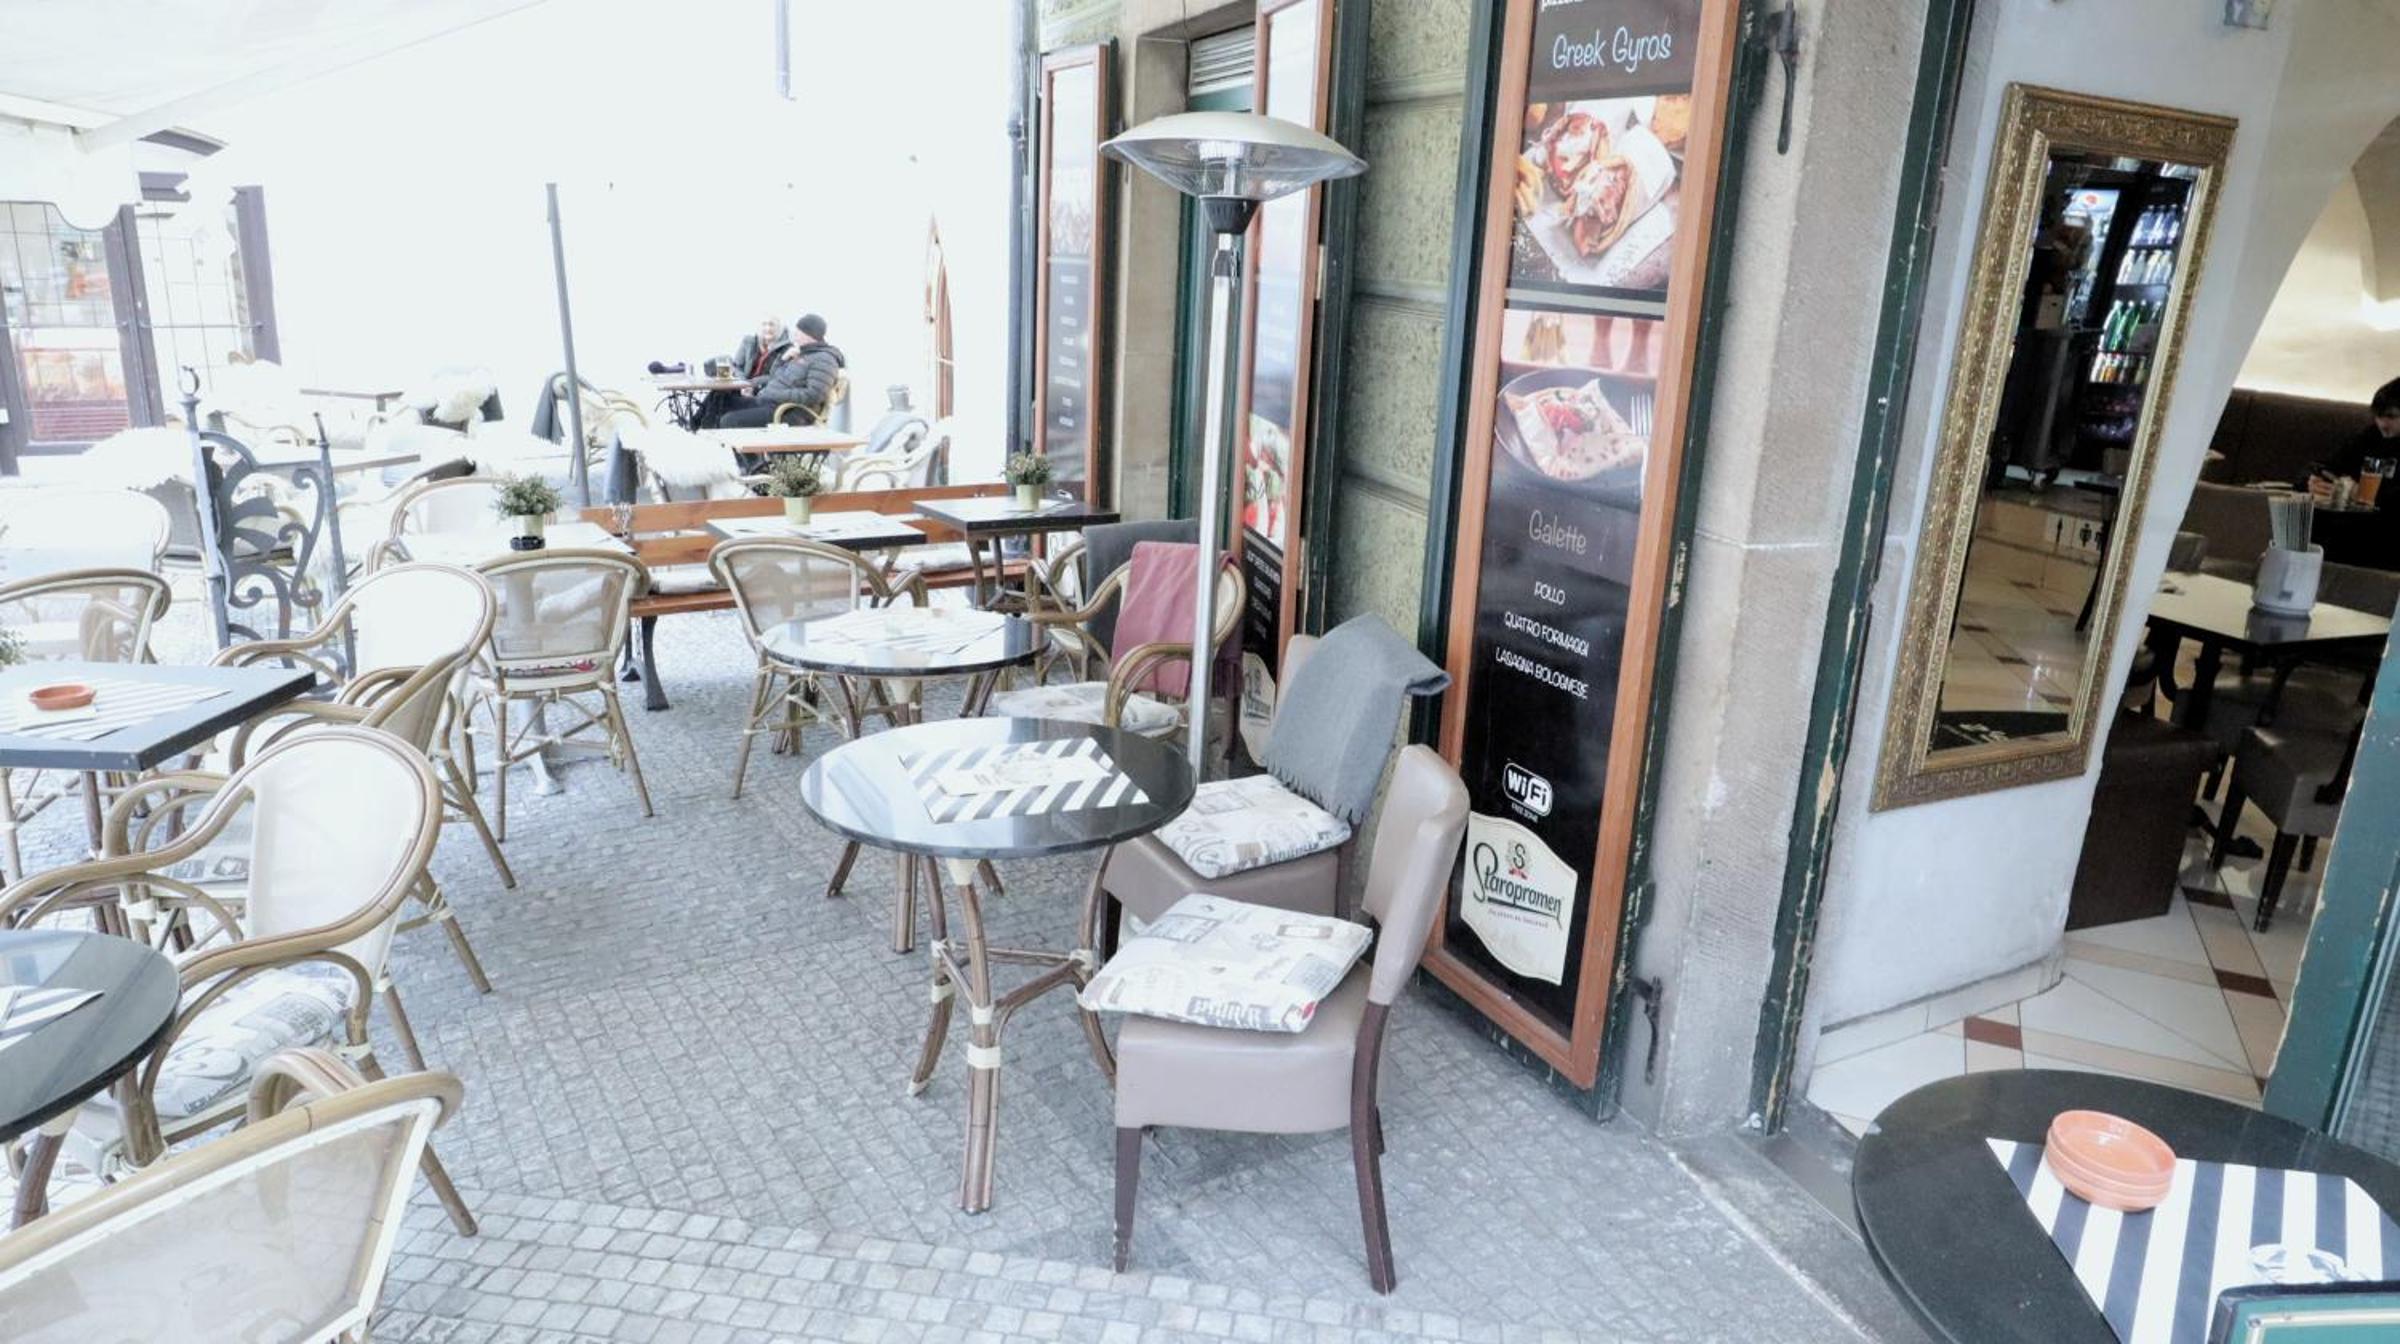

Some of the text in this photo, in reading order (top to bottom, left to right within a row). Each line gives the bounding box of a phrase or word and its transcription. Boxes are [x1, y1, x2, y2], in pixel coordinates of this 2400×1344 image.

[1553, 25, 1672, 73] Greek Gyros
[1529, 509, 1587, 555] Galette
[1534, 581, 1566, 605] POLLO
[1504, 611, 1590, 658] QUATRO FORMAGGI
[1495, 646, 1589, 700] LASAGNA BOLOGNESE
